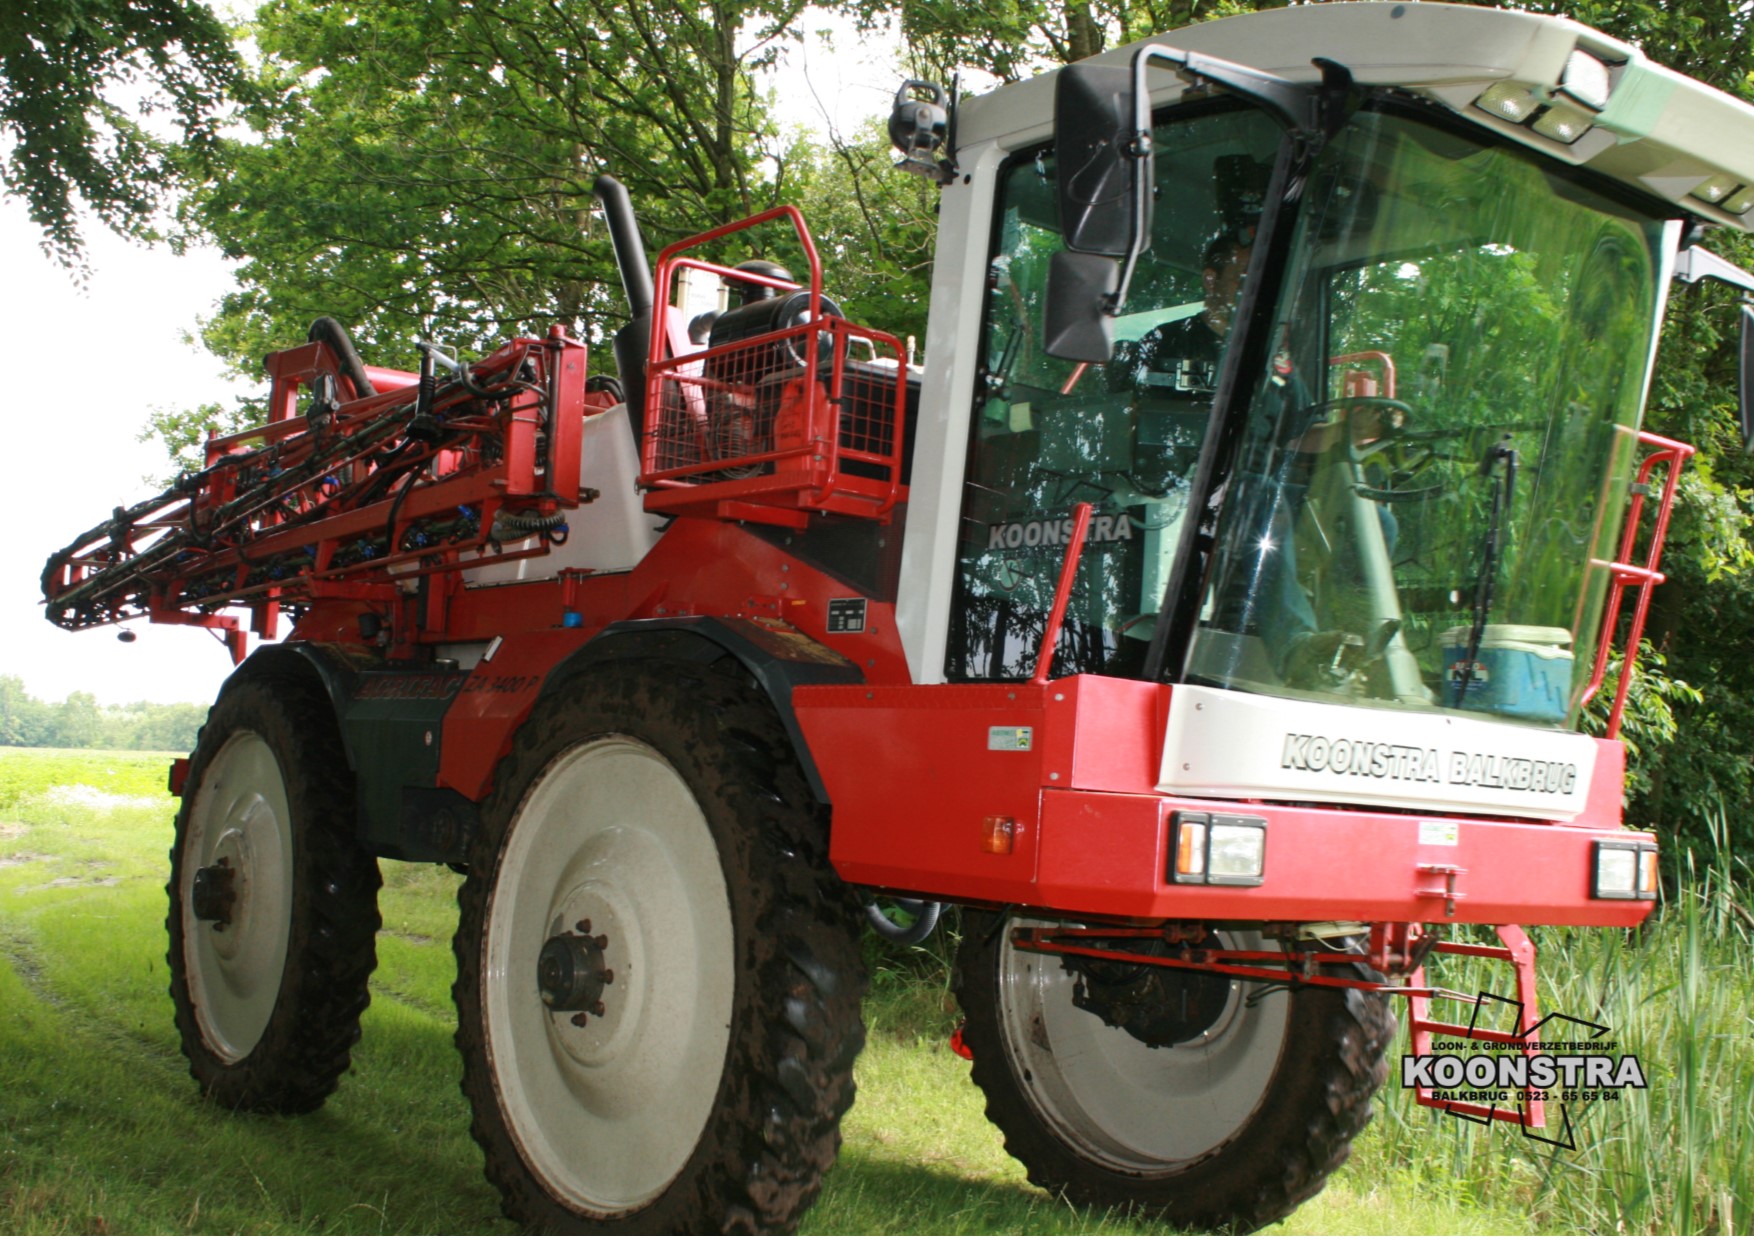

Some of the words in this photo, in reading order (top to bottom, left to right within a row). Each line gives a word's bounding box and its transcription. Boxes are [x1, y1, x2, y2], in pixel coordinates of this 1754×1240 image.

[988, 514, 1133, 549] KOONSTRA
[1281, 733, 1440, 783] KOONSTRA
[1449, 751, 1577, 795] BALKBRUG
